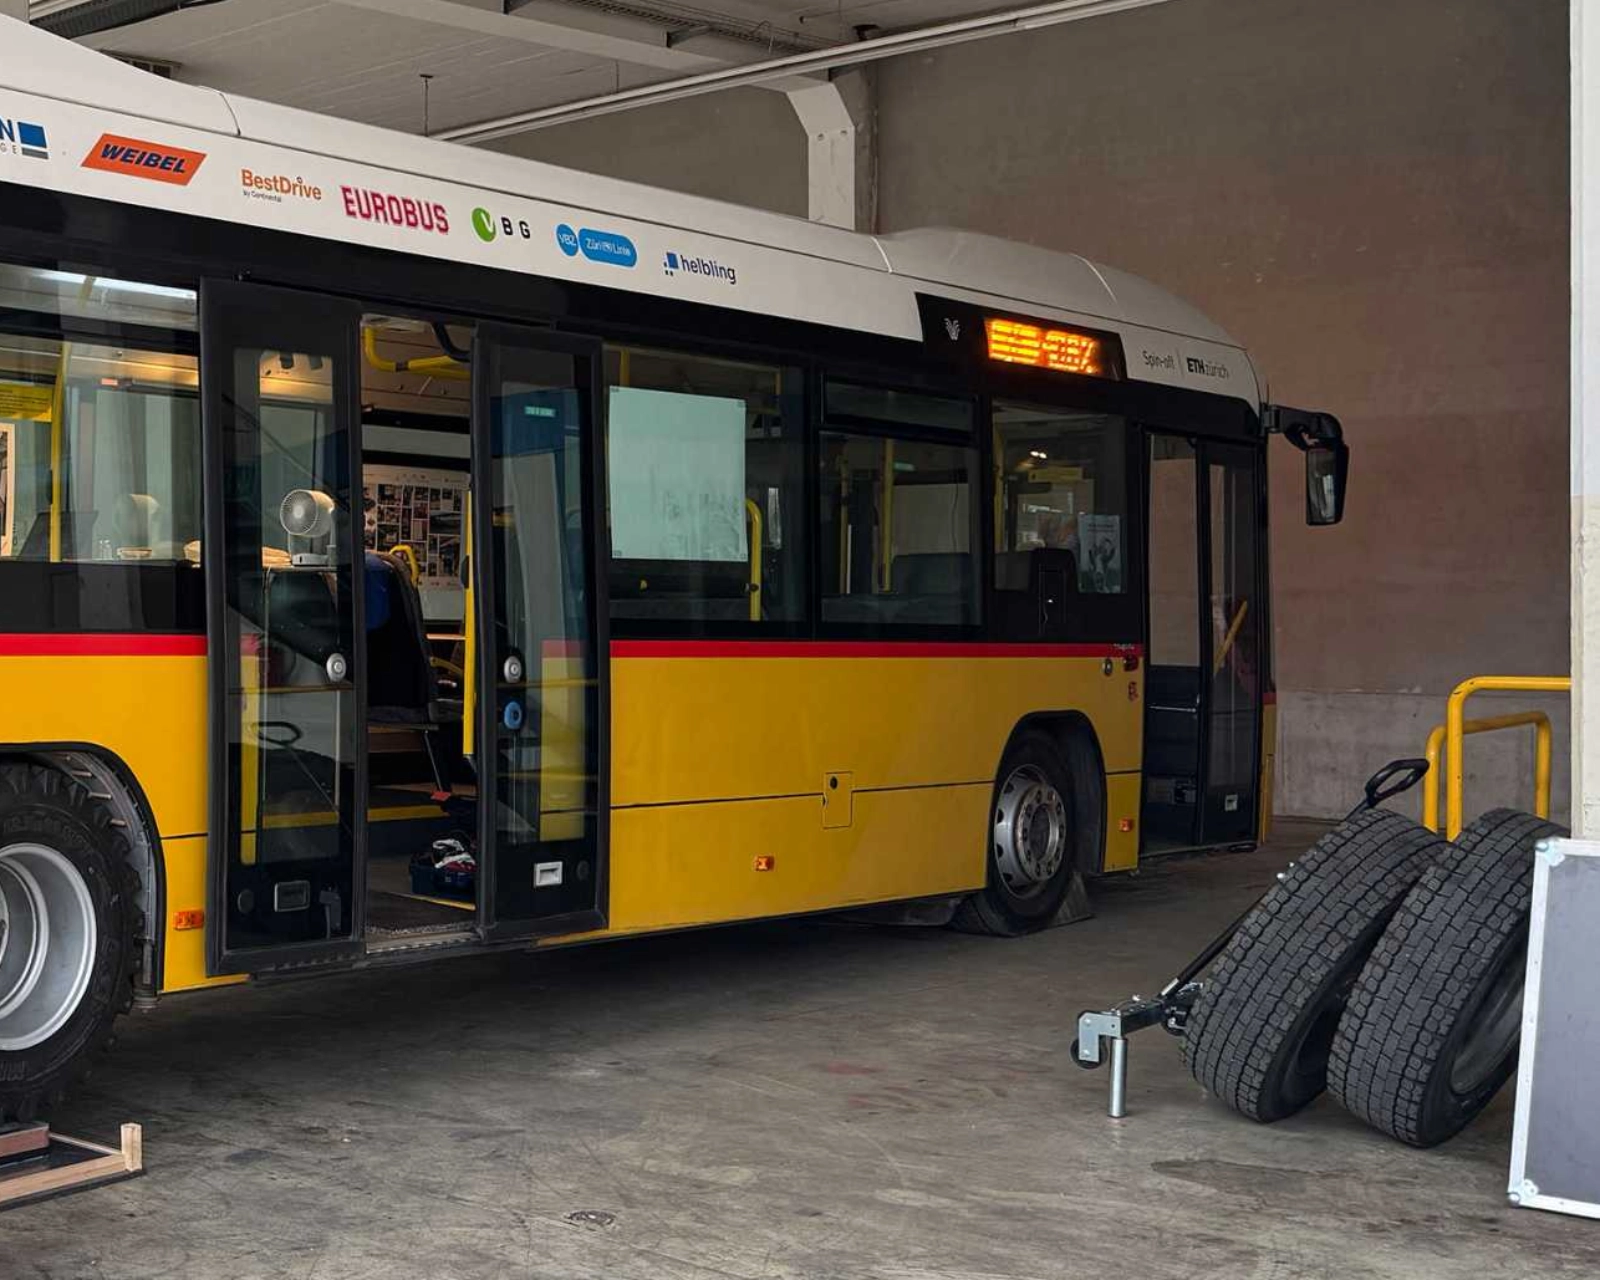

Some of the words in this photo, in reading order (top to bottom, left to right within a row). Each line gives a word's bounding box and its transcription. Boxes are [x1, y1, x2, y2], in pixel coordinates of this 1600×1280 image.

[100, 143, 187, 174] WEIBEL
[241, 169, 322, 200] BestDrive
[341, 185, 449, 234] EUROBUS
[681, 254, 736, 285] helbling
